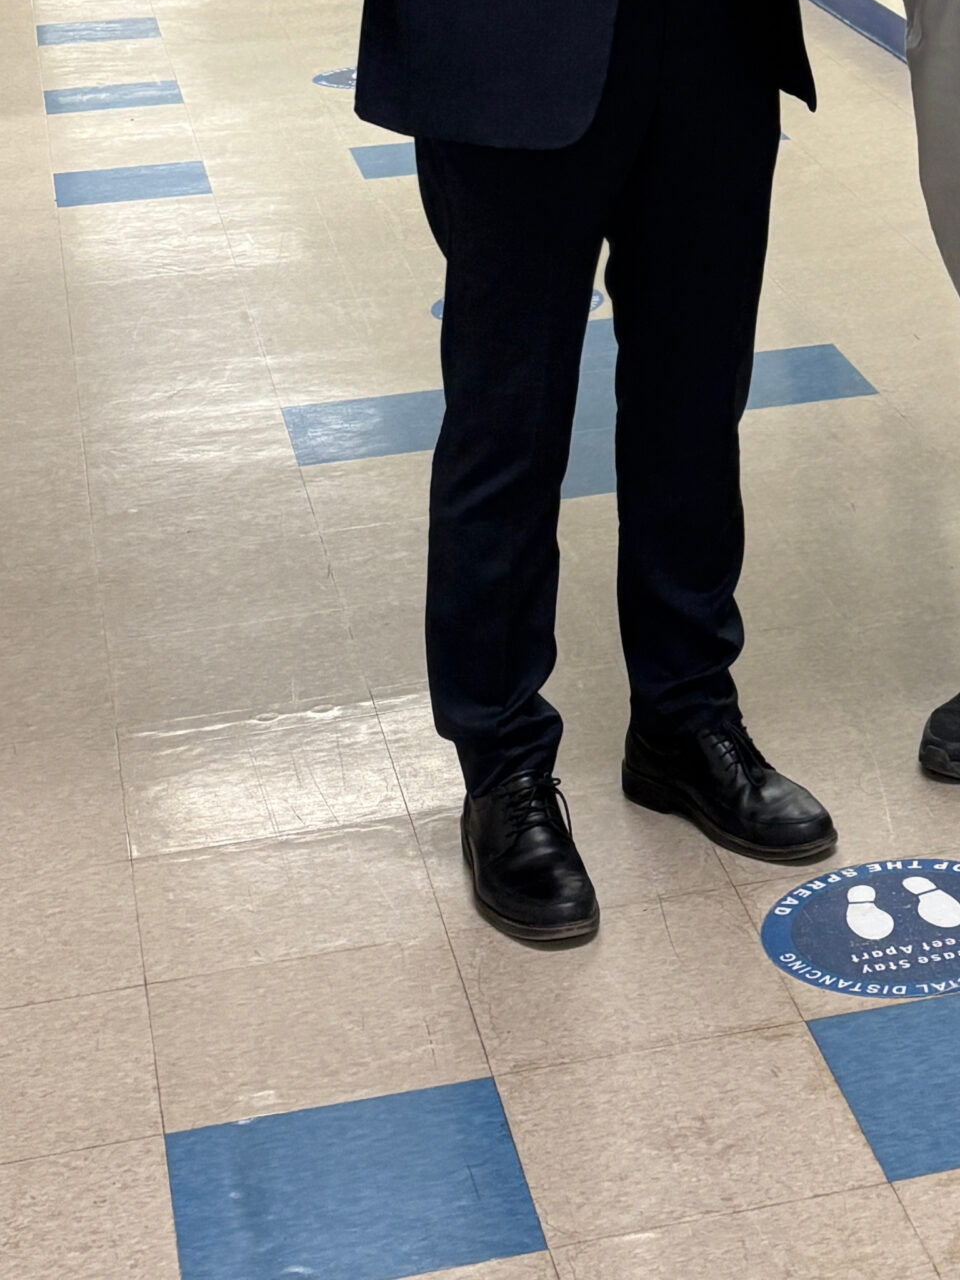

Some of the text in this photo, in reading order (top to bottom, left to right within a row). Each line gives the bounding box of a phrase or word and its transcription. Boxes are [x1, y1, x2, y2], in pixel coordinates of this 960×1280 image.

[866, 860, 922, 873] THE
[774, 868, 857, 916] SPREAD
[850, 944, 914, 963] Apart
[779, 953, 906, 996] DISTANCING
[862, 958, 911, 974] Stay
